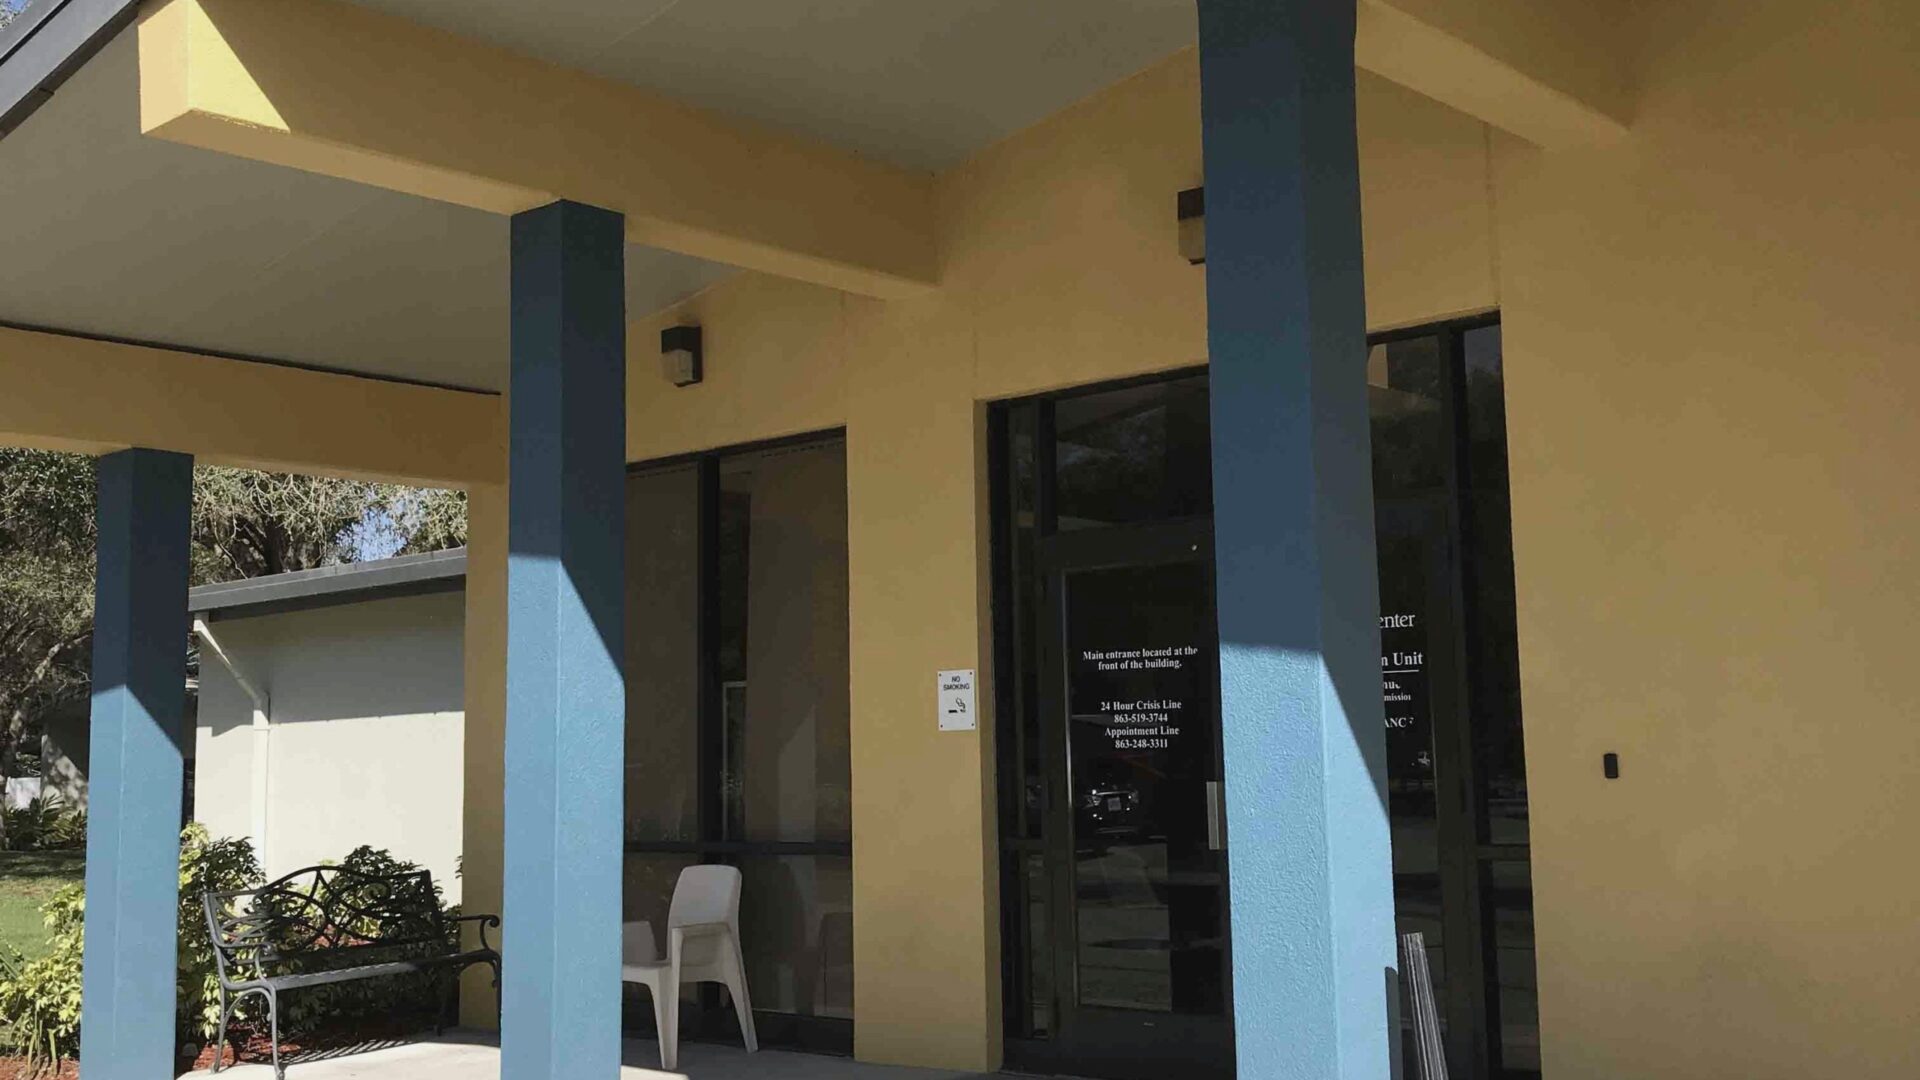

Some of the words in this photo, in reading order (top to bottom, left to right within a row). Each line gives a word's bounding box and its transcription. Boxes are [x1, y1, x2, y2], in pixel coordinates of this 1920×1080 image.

[1083, 651, 1104, 660] Main
[1105, 650, 1141, 659] entrance
[1142, 647, 1172, 657] located
[1173, 647, 1182, 656] at
[1184, 645, 1199, 655] the
[1392, 651, 1423, 666] Unit
[1098, 661, 1118, 670] front
[1120, 660, 1129, 670] of
[1130, 660, 1143, 669] the
[1145, 658, 1182, 669] building.
[943, 682, 970, 691] SMOKING
[1101, 701, 1110, 711] 24
[1113, 701, 1135, 711] Hour
[1136, 700, 1160, 710] Crisis
[1162, 699, 1182, 709] Line
[1114, 713, 1168, 723] 863-519-3744
[1104, 726, 1158, 738] Appointment
[1160, 725, 1180, 735] Line
[1115, 738, 1168, 749] 863-248-3311
